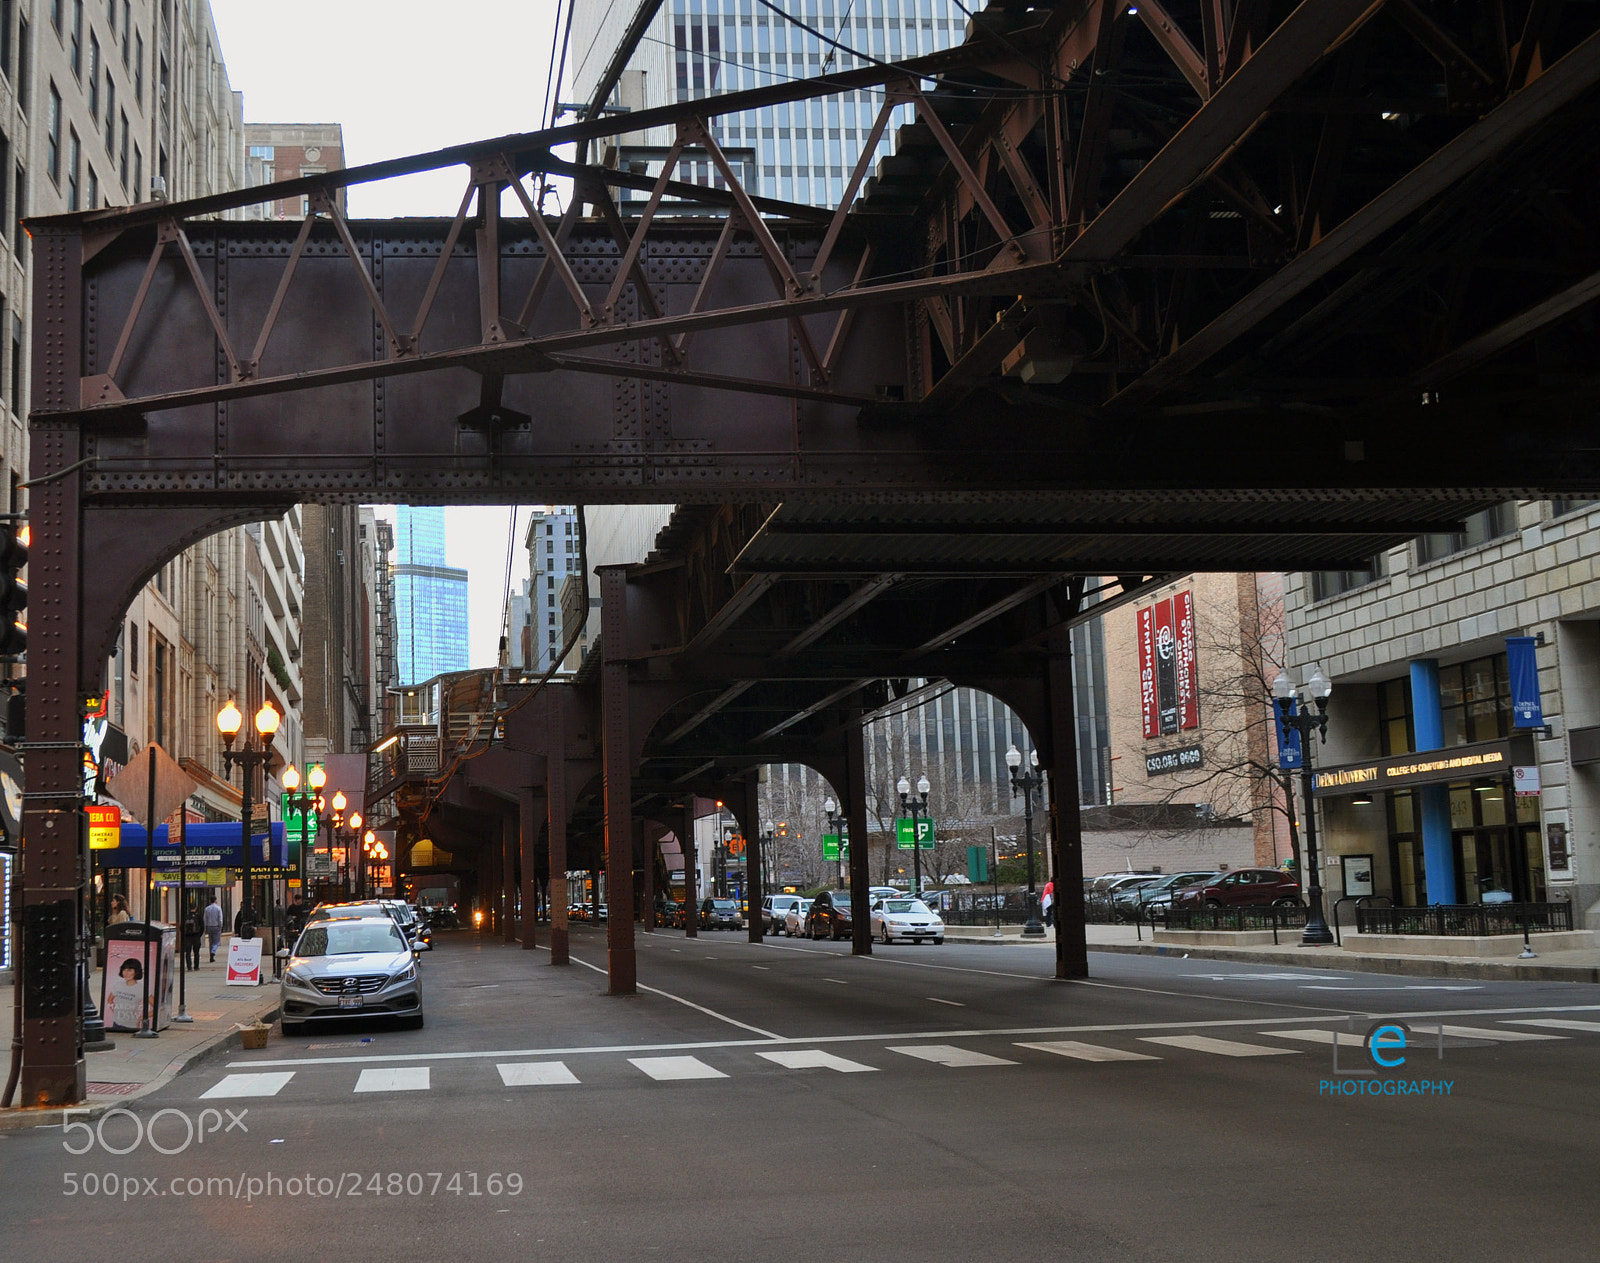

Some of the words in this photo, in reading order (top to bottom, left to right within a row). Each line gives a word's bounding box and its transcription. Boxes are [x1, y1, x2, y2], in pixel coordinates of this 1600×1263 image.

[1184, 594, 1193, 662] CHICAGO
[1143, 611, 1155, 704] SYMPHONY
[1181, 619, 1191, 700] SYMPHONY
[1142, 669, 1151, 736] CENTER
[1177, 640, 1187, 726] ORCHESTRA
[1147, 754, 1178, 771] CSO.ORG
[1338, 767, 1378, 785] UNIVERSITY
[1386, 765, 1411, 776] COLLEGE
[1410, 764, 1418, 774] OF
[1418, 760, 1449, 772] COMPUTING
[1449, 758, 1462, 768] AND
[1461, 755, 1483, 767] DIGITAL
[1482, 752, 1503, 763] MEDIA
[89, 813, 104, 822] ERA
[183, 846, 205, 855] ealth
[208, 847, 234, 855] Foods
